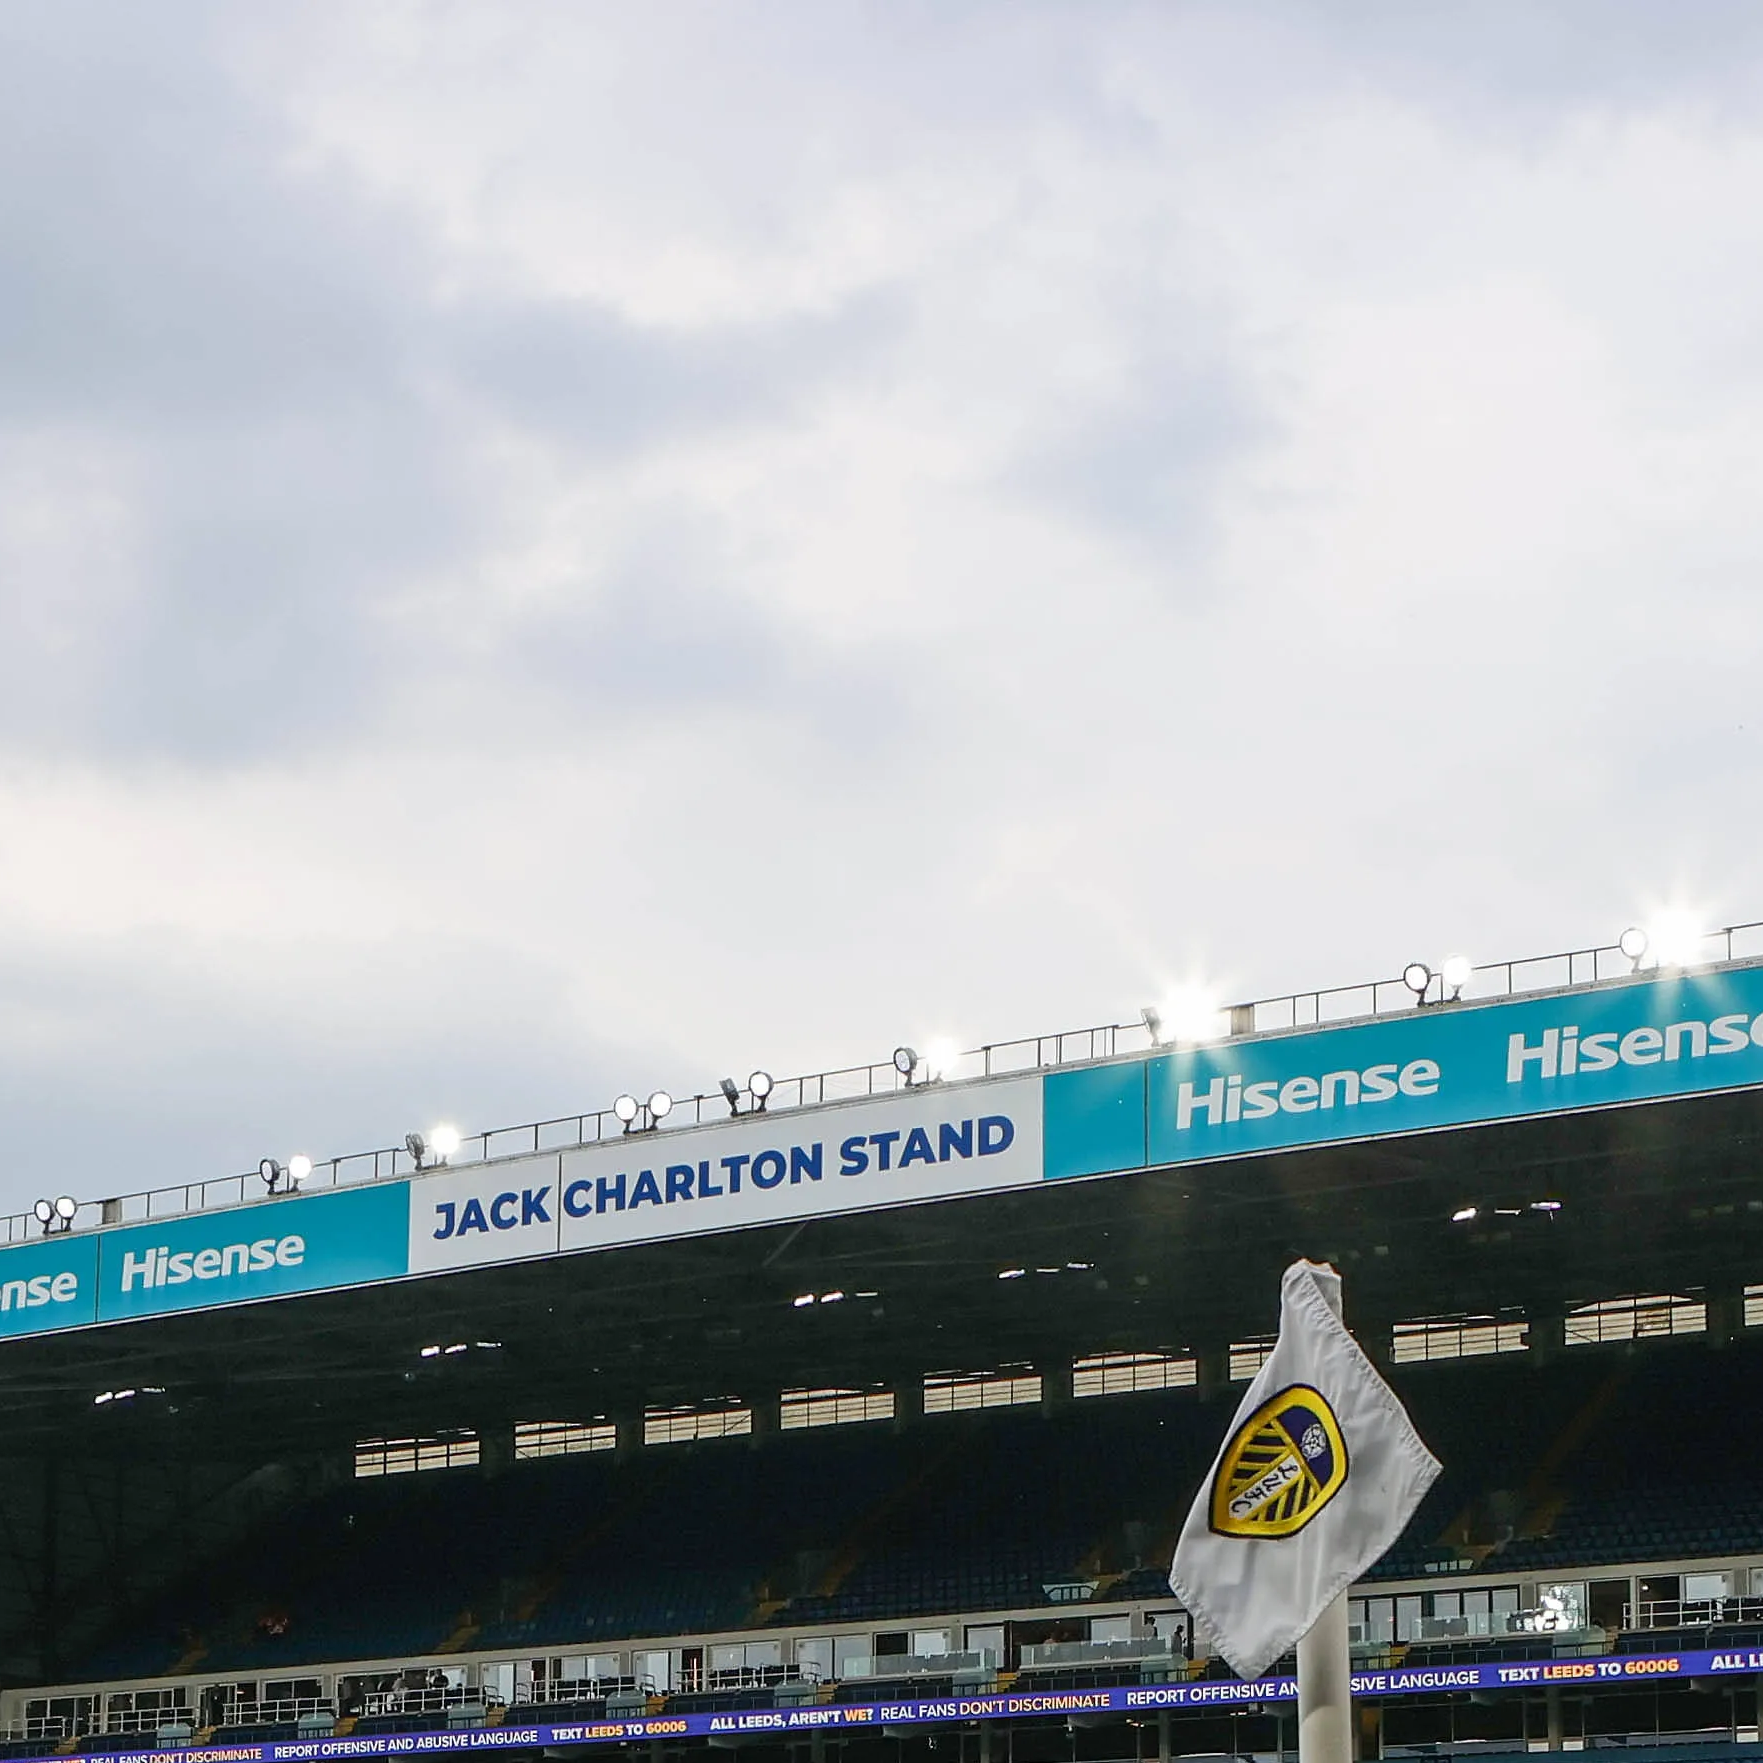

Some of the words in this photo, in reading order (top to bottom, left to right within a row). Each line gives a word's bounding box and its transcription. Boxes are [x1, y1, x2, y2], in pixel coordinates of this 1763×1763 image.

[1176, 1059, 1439, 1131] Hisense
[433, 1185, 550, 1240] JACK
[563, 1144, 823, 1219] CHARLTON
[839, 1114, 1014, 1177] STAND
[122, 1232, 305, 1292] Hisense
[1499, 1667, 1539, 1681] TEXT
[1544, 1664, 1595, 1678] LEEDS
[1598, 1663, 1621, 1676] TO
[1625, 1658, 1679, 1674] 60006
[1711, 1655, 1745, 1669] ALL
[1128, 1689, 1186, 1705] REPORT
[1190, 1684, 1275, 1701] OFFENSIVE
[1279, 1682, 1300, 1696] AN
[1351, 1677, 1385, 1691] SIVE
[1391, 1671, 1479, 1688] LANGUAGE
[711, 1717, 735, 1729] ALL
[739, 1714, 786, 1728] LEEDS,
[844, 1708, 873, 1721] WE?
[881, 1707, 915, 1720] REAL
[920, 1703, 956, 1717] FANS
[1009, 1694, 1109, 1712] DISCRIMINATE
[275, 1744, 319, 1758] REPORT
[322, 1740, 385, 1755] OFFENSIVE
[388, 1738, 413, 1750] AND
[417, 1735, 468, 1748] ABUSIVE
[471, 1731, 537, 1745] LANGUAGE
[552, 1728, 583, 1740] TEXT
[586, 1725, 623, 1738] LEEDS
[626, 1724, 643, 1735] TO
[646, 1721, 686, 1734] 60006
[186, 1745, 261, 1763] DISCRIMINATE
